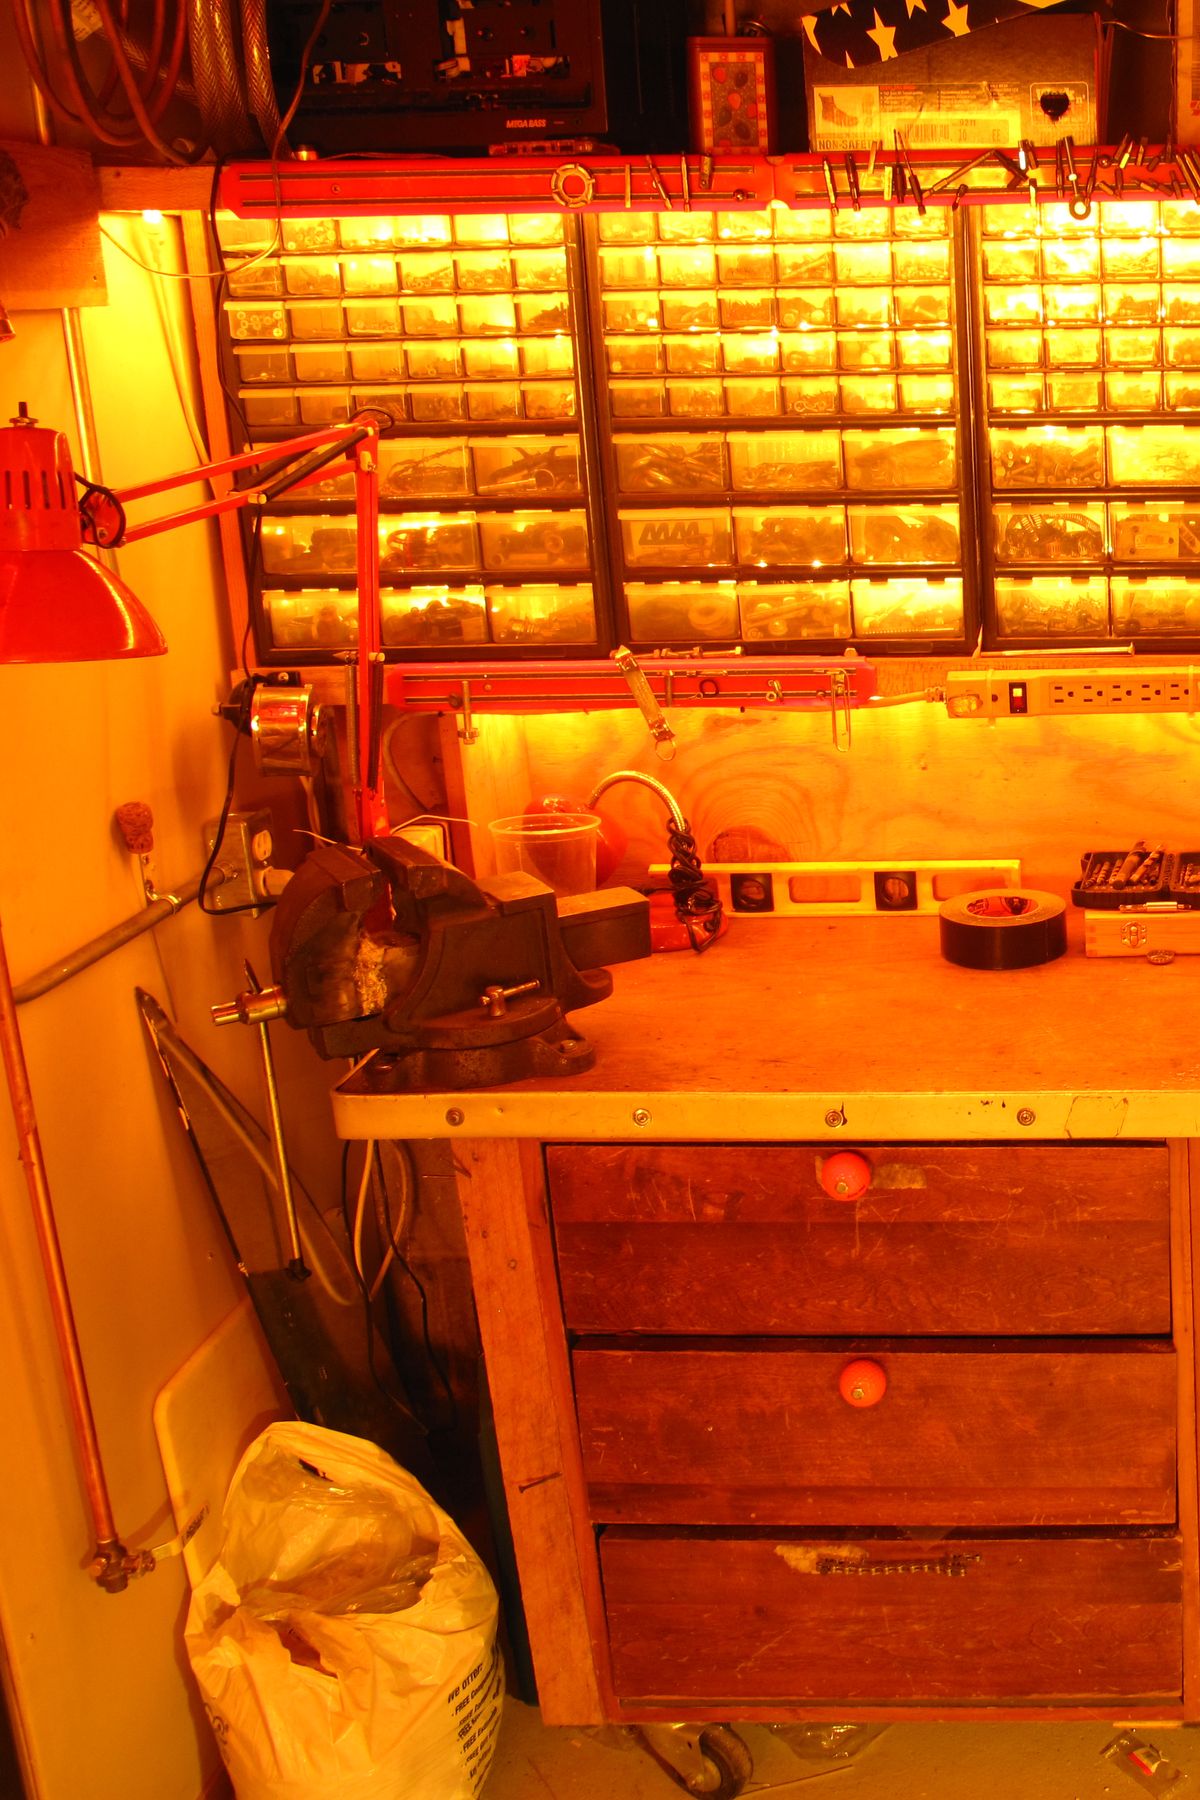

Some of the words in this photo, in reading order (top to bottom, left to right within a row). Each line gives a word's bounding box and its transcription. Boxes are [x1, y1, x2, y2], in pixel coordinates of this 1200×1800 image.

[506, 119, 528, 128] MEGA
[528, 119, 546, 128] BASS
[455, 1695, 470, 1715] FREE
[463, 1732, 478, 1753] FREE
